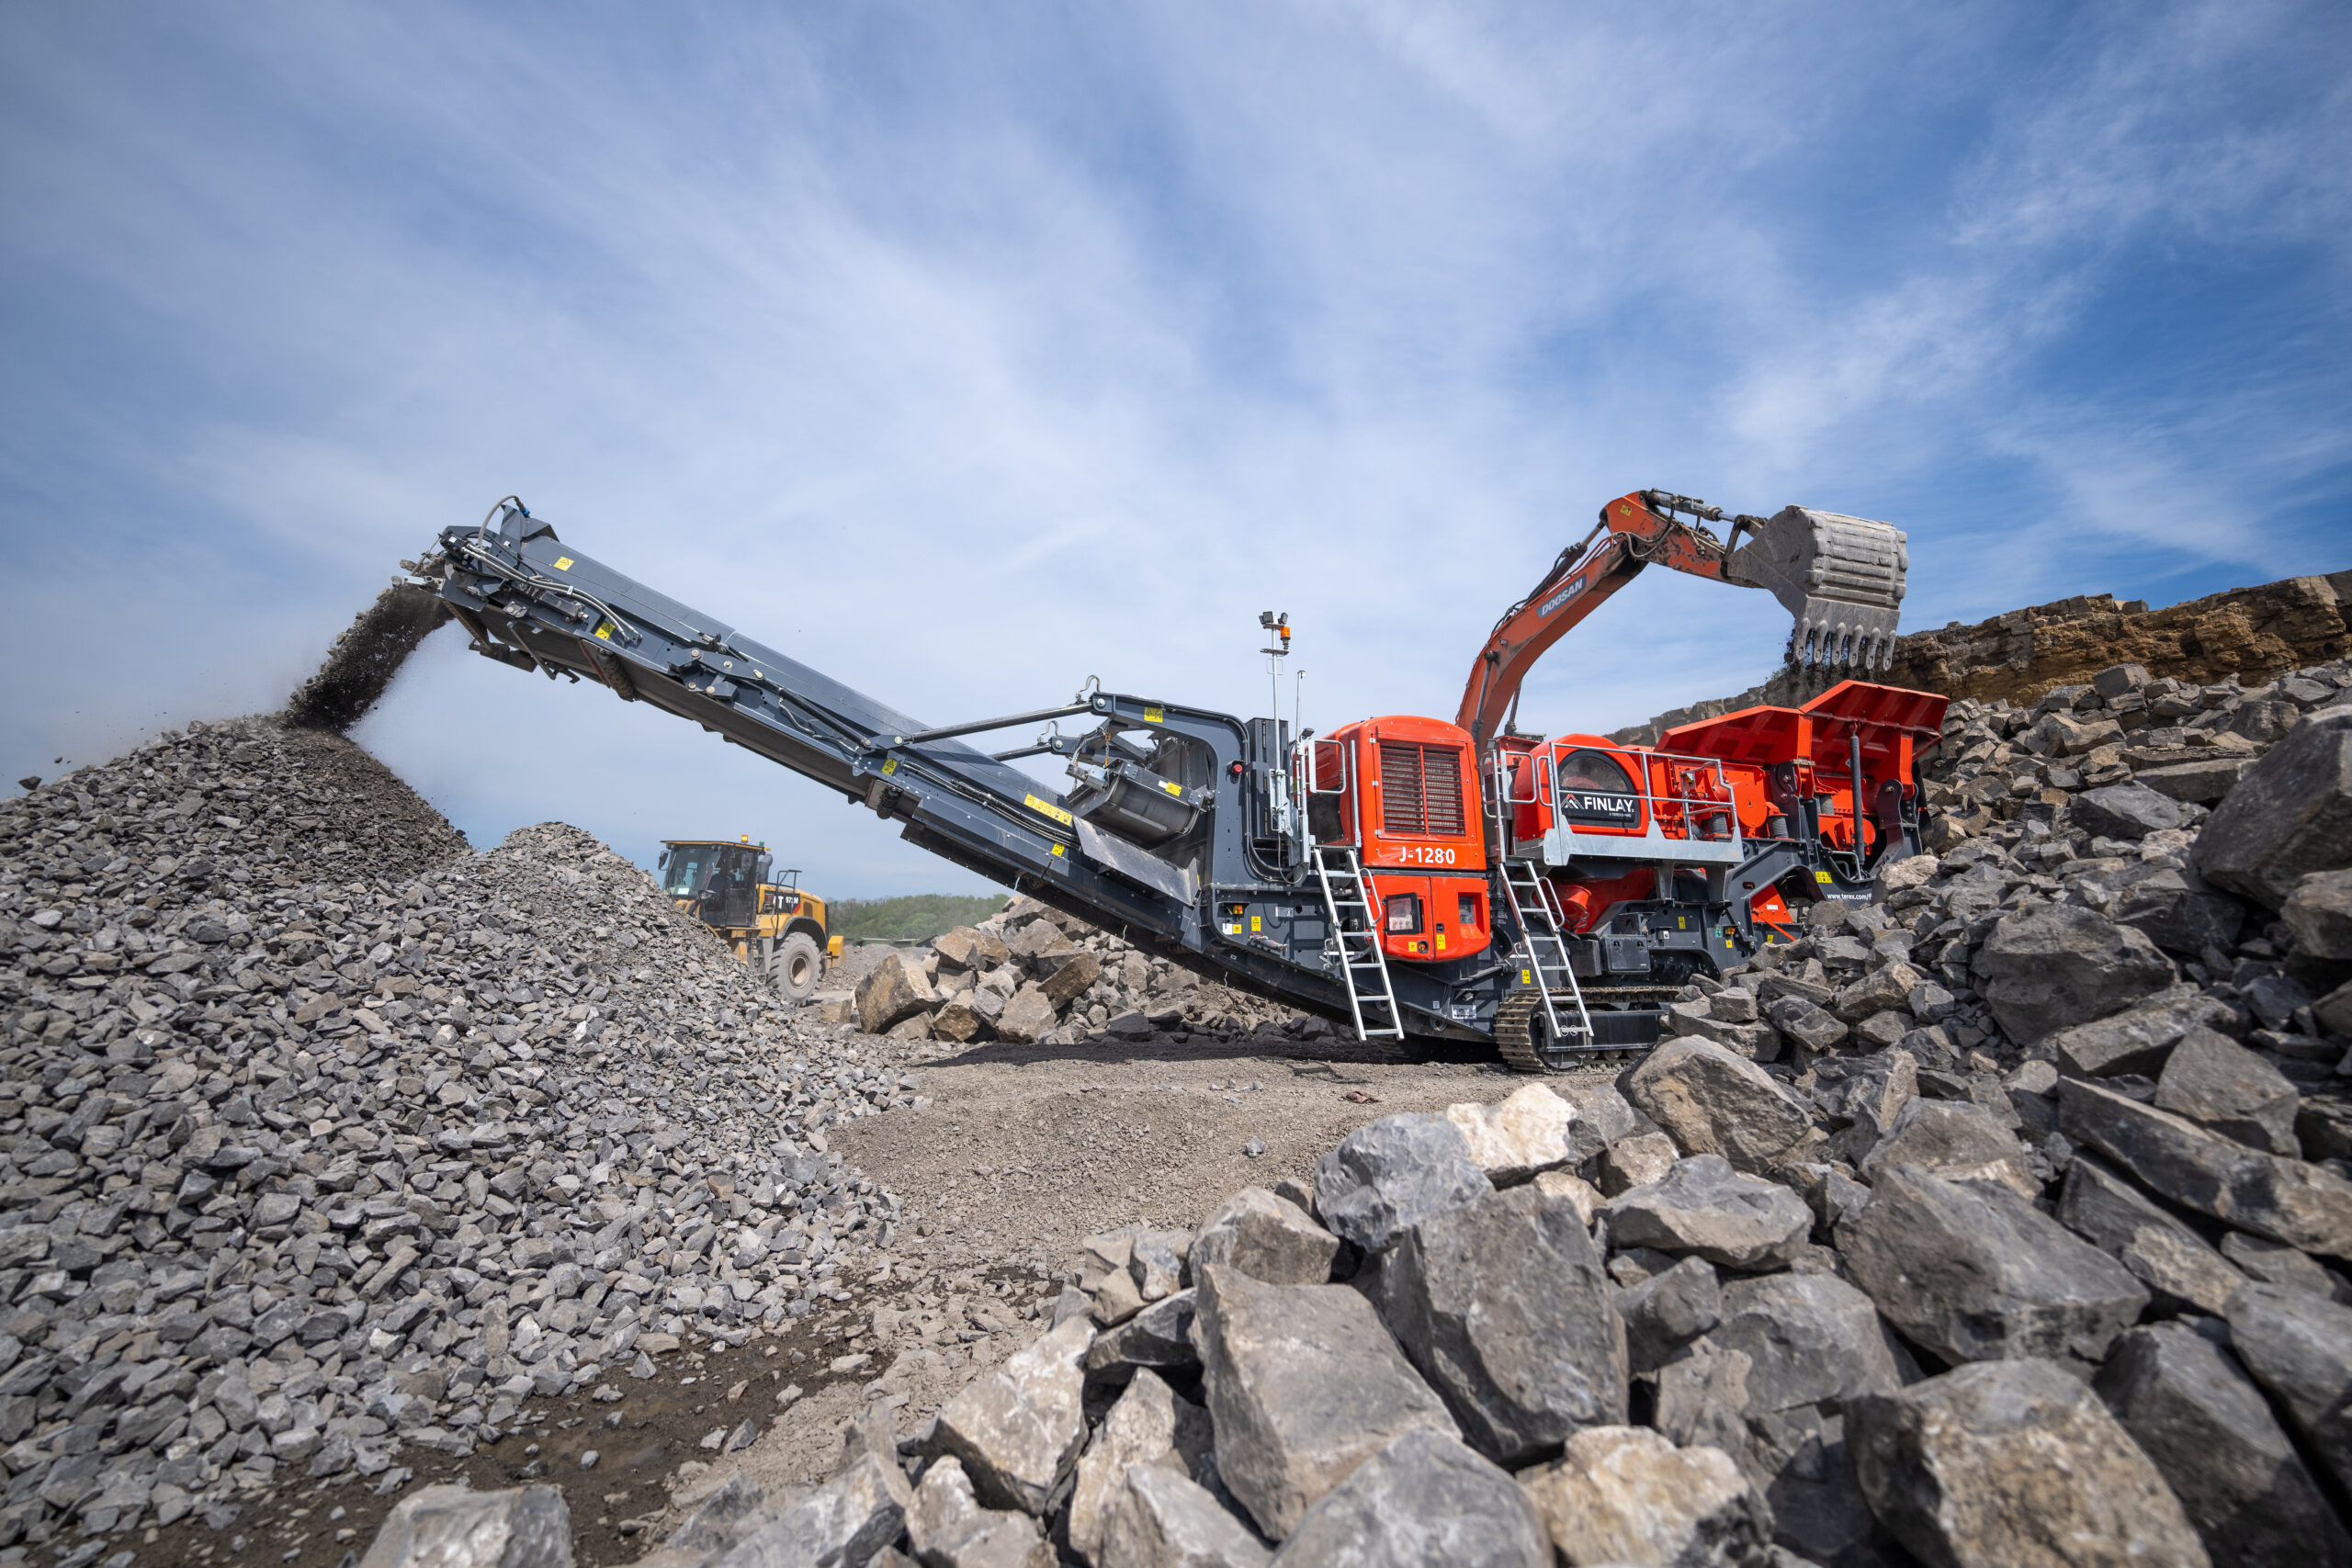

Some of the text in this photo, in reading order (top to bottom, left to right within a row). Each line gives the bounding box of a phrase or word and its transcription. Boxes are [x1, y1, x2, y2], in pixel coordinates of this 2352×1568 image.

[1542, 578, 1583, 616] DOOSAN
[1584, 796, 1633, 813] FINLAY
[1398, 846, 1455, 864] J-1280
